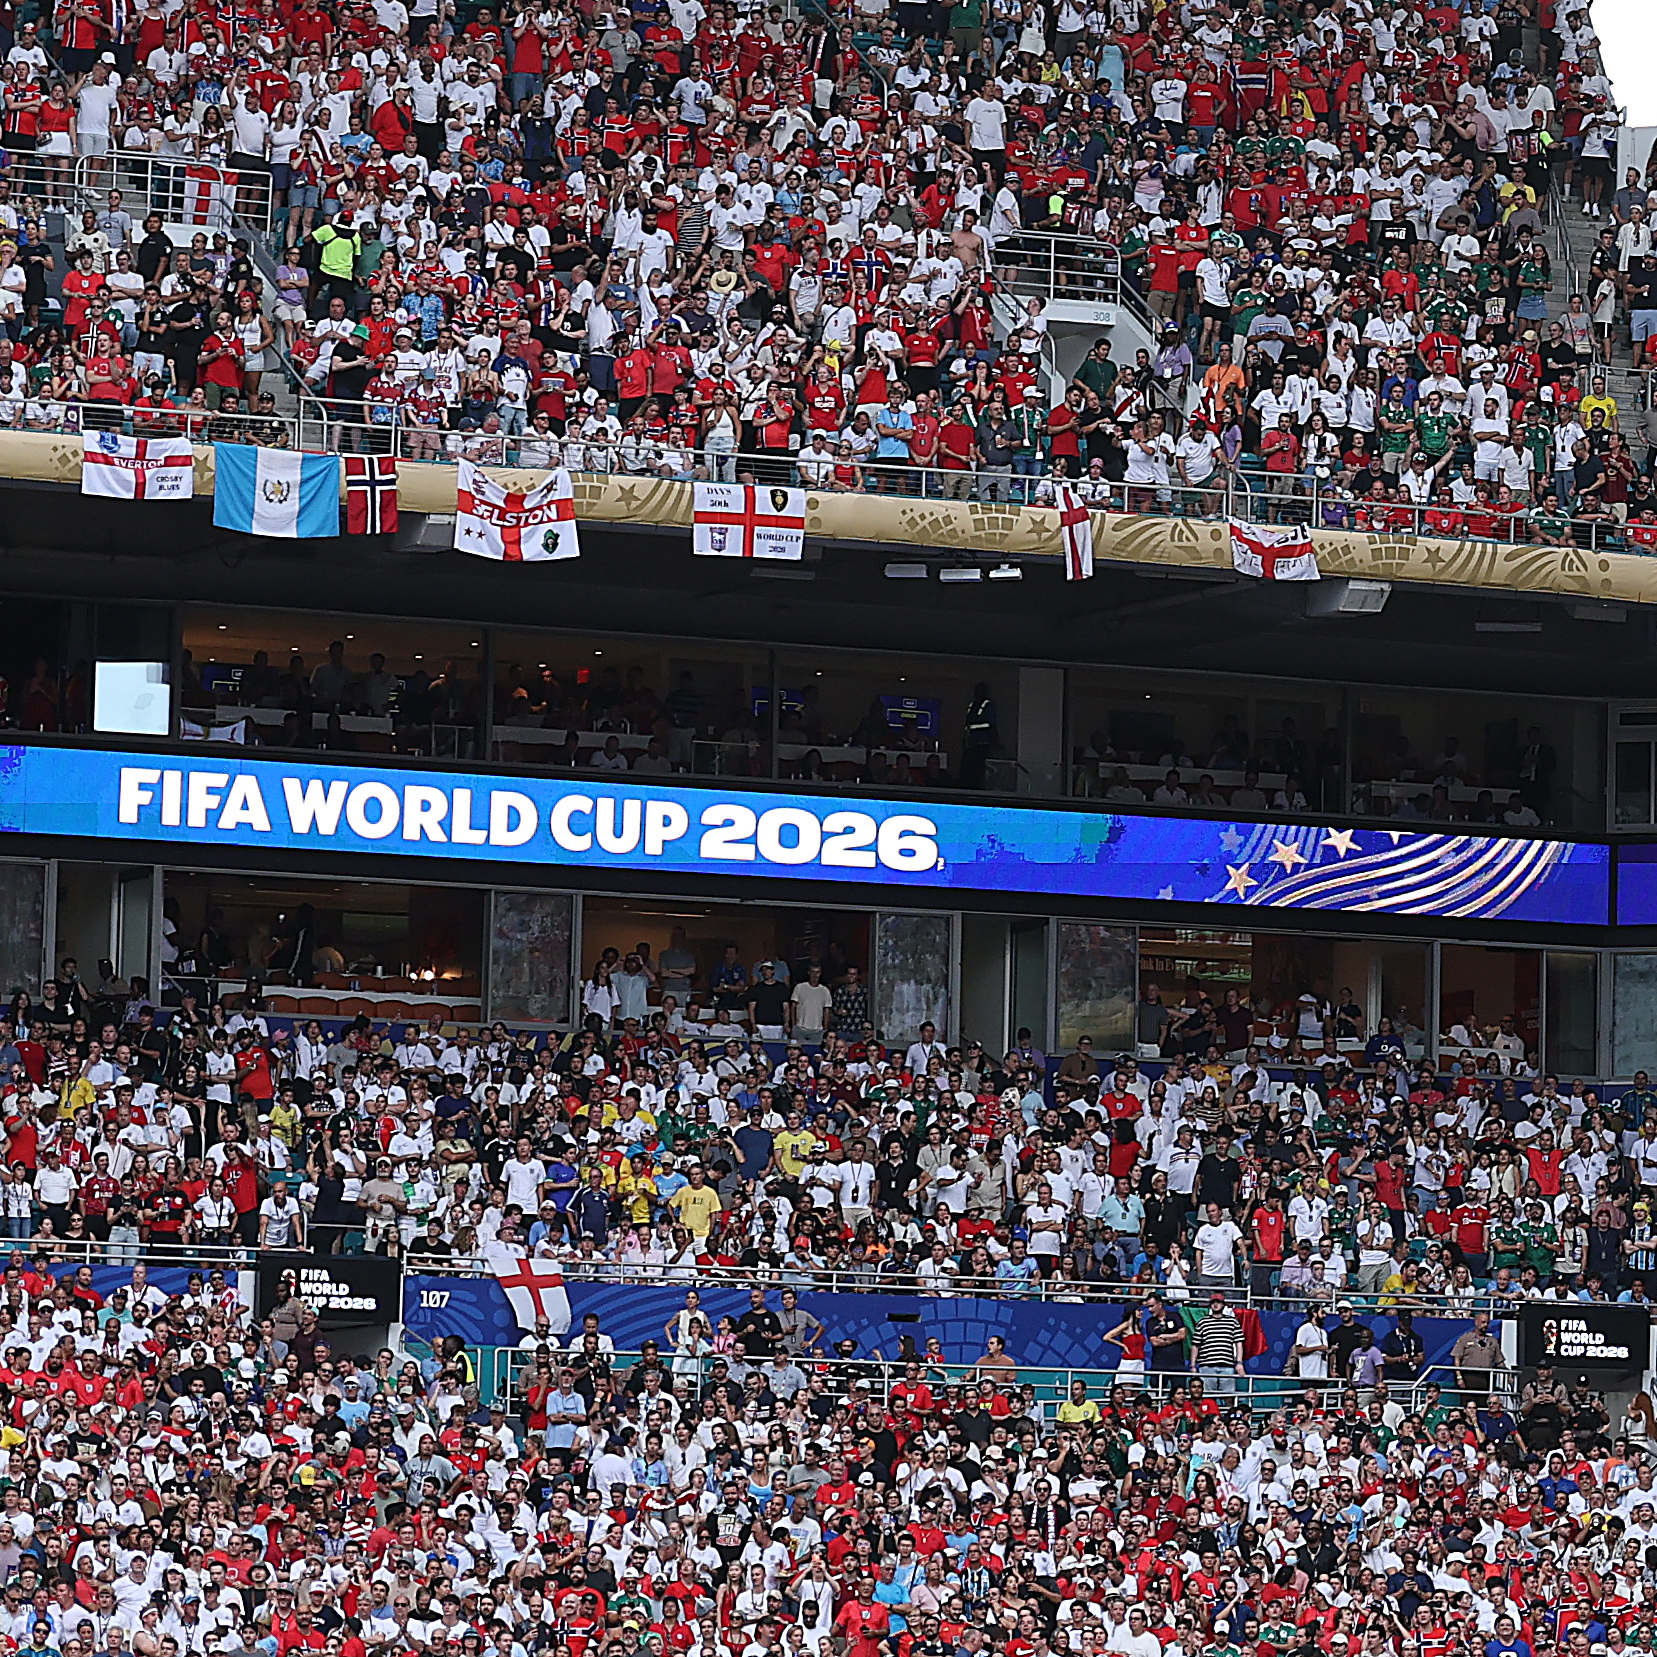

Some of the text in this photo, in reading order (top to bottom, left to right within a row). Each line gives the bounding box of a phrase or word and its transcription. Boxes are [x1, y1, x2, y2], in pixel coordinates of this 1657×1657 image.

[1093, 311, 1111, 323] 308
[755, 532, 803, 544] WORLD CUP
[119, 767, 939, 872] FIFA WORLD CUP 2026
[300, 1268, 330, 1282] FIFA
[299, 1281, 350, 1296] WORLD
[328, 1295, 377, 1310] 2026
[420, 1290, 450, 1309] 107
[1560, 1319, 1588, 1332] FIFA
[1560, 1331, 1605, 1345] WORLD
[1560, 1344, 1629, 1359] CUP 2026
